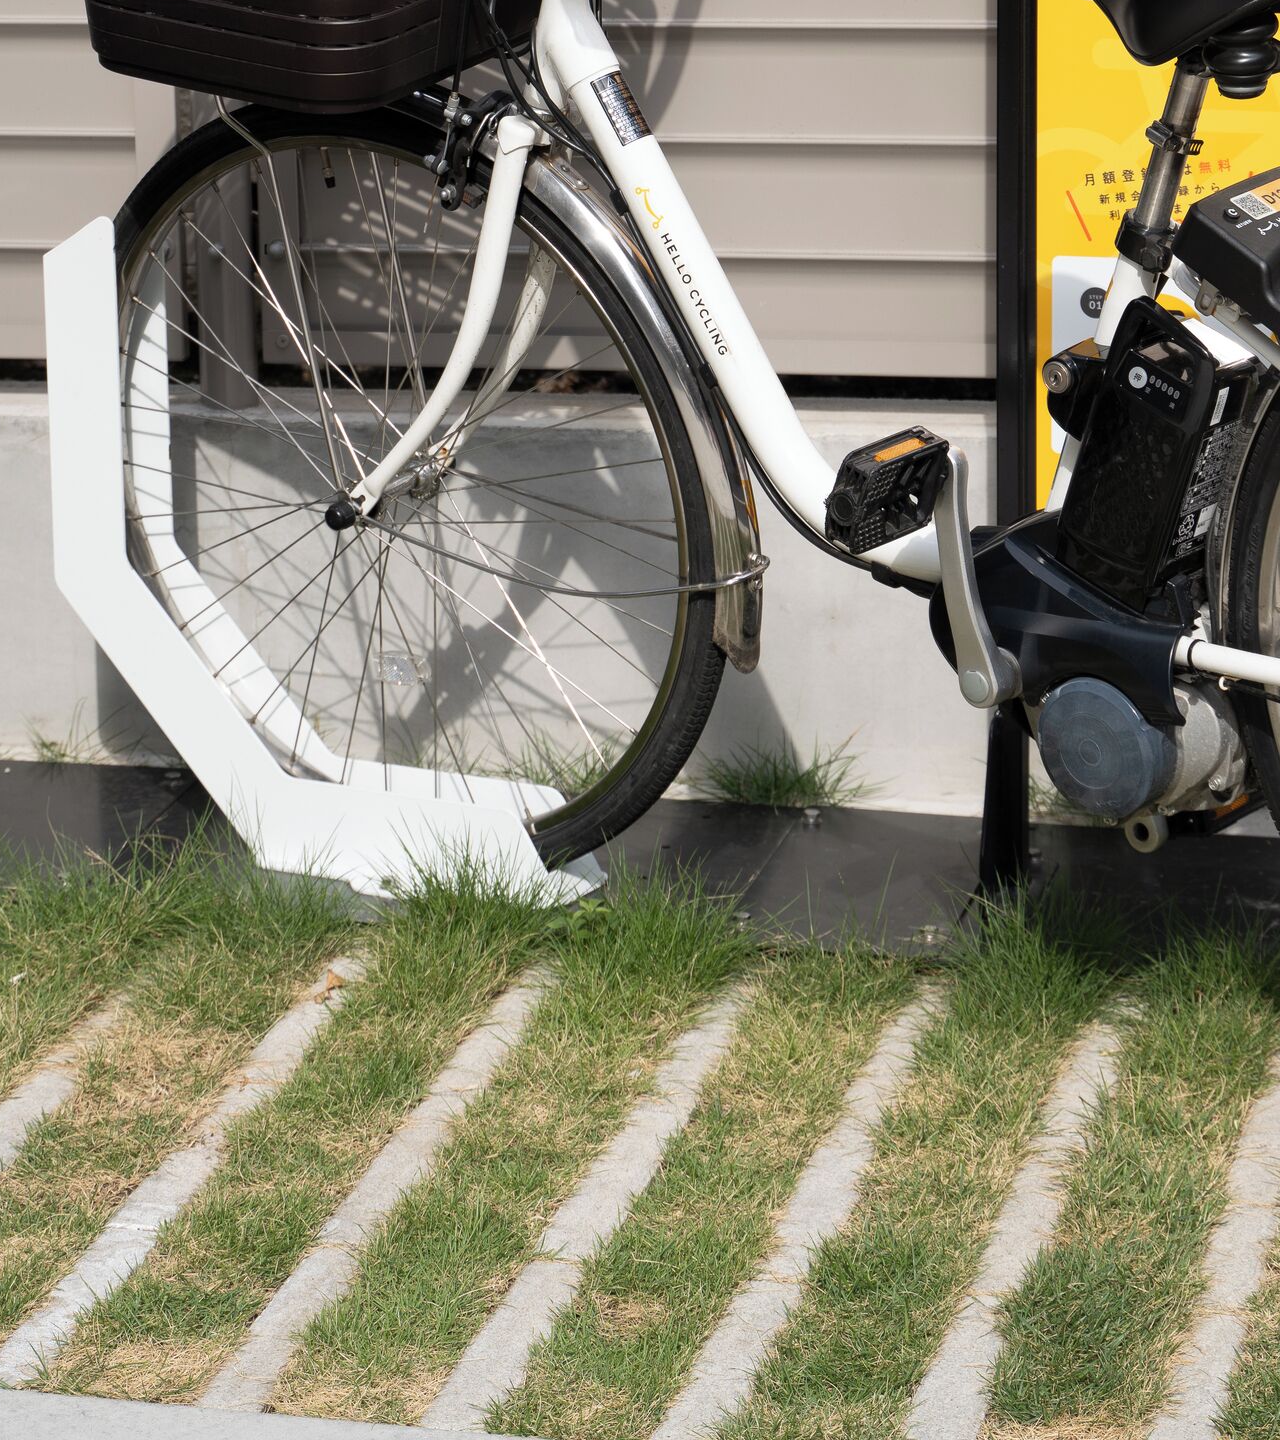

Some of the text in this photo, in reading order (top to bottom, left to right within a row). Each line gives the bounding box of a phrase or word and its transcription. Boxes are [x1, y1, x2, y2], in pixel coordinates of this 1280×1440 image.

[1235, 218, 1253, 229] RETURN
[660, 232, 728, 357] HELLO CYCLING
[1089, 300, 1102, 310] 01
